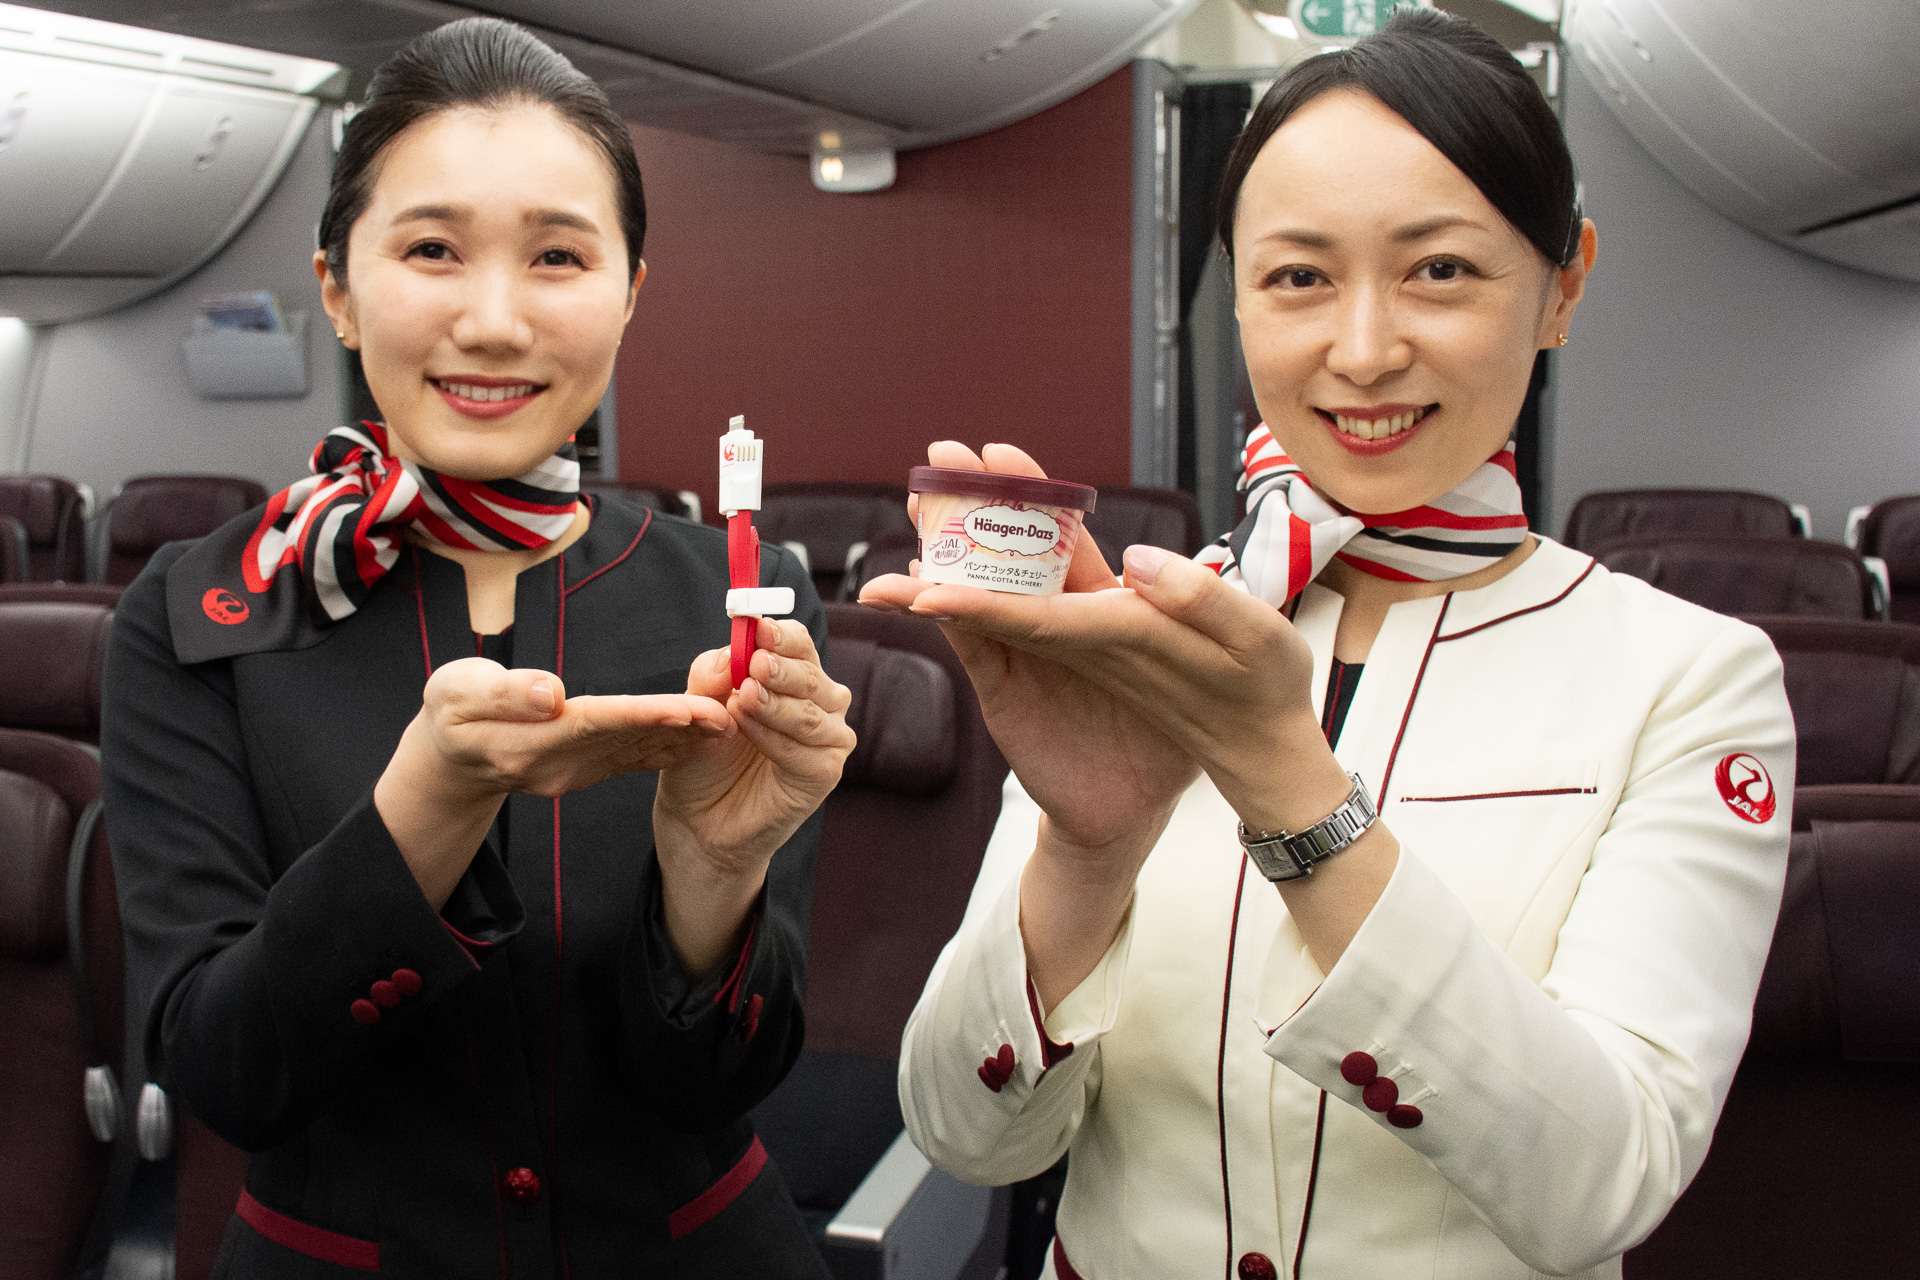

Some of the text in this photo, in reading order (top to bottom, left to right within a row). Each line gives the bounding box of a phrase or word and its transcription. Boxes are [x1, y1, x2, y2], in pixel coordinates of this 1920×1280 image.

[942, 538, 961, 549] JAL
[967, 573, 990, 581] PANNA
[992, 576, 1013, 585] COTTA
[1021, 580, 1043, 588] CHERRY
[1727, 795, 1762, 822] JAL
